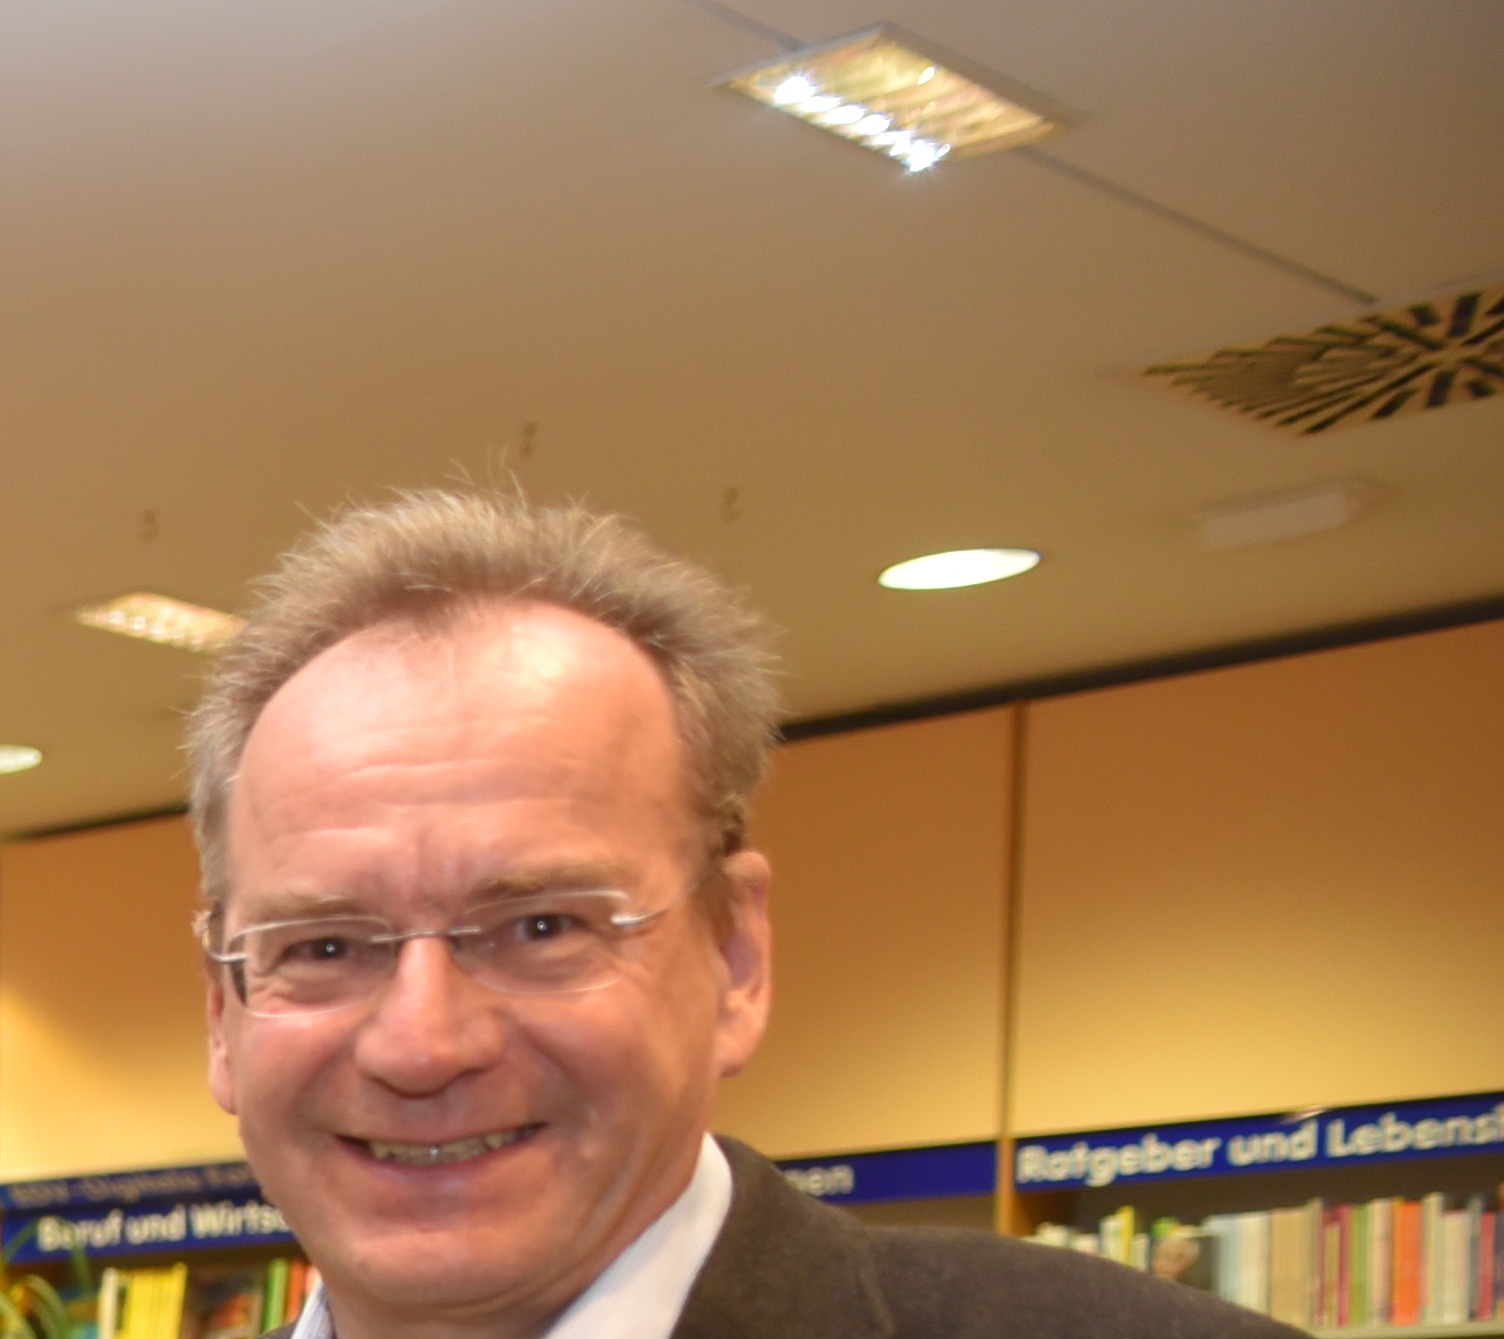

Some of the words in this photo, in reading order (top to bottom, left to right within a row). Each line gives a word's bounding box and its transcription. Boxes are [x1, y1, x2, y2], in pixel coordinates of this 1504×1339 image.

[1016, 1133, 1221, 1187] Ratgeber
[1228, 1120, 1318, 1166] und
[1326, 1104, 1504, 1157] Lebens
[39, 1210, 123, 1251] Beruf
[125, 1204, 186, 1245] und
